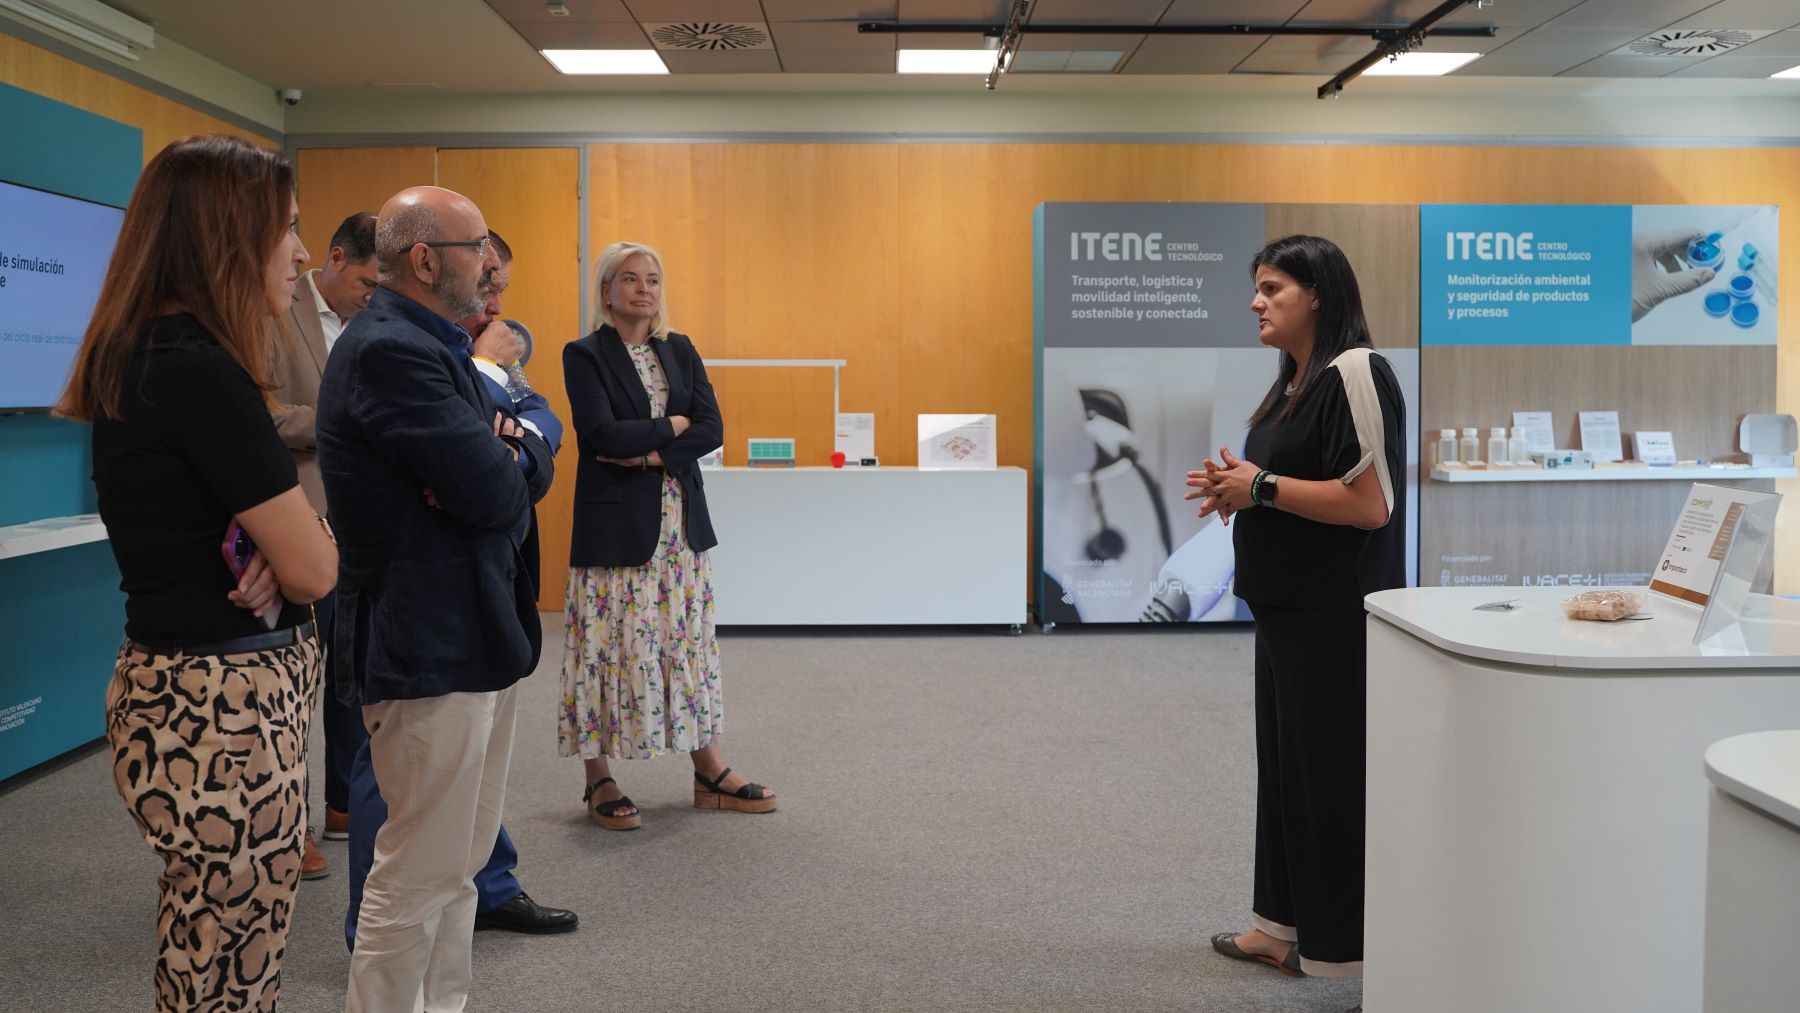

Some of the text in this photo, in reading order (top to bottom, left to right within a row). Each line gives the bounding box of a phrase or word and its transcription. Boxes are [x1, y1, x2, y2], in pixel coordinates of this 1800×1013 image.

[1071, 232, 1162, 261] ITENE
[1167, 243, 1199, 251] CENTRO
[1447, 232, 1533, 261] ITENE
[1538, 242, 1568, 251] CENTRO
[1168, 251, 1223, 261] TECNOLÓGICO
[1538, 251, 1591, 261] TECNOLÓGICO
[11, 253, 64, 276] simulación
[1072, 275, 1203, 289] Transporte, logística y
[1448, 274, 1591, 285] Monitorización ambiental
[1072, 291, 1201, 305] movilidad inteligente,
[1448, 290, 1590, 303] y seguridad de productos
[1072, 307, 1208, 321] sostenible y conectada
[1448, 308, 1509, 320] y procesos
